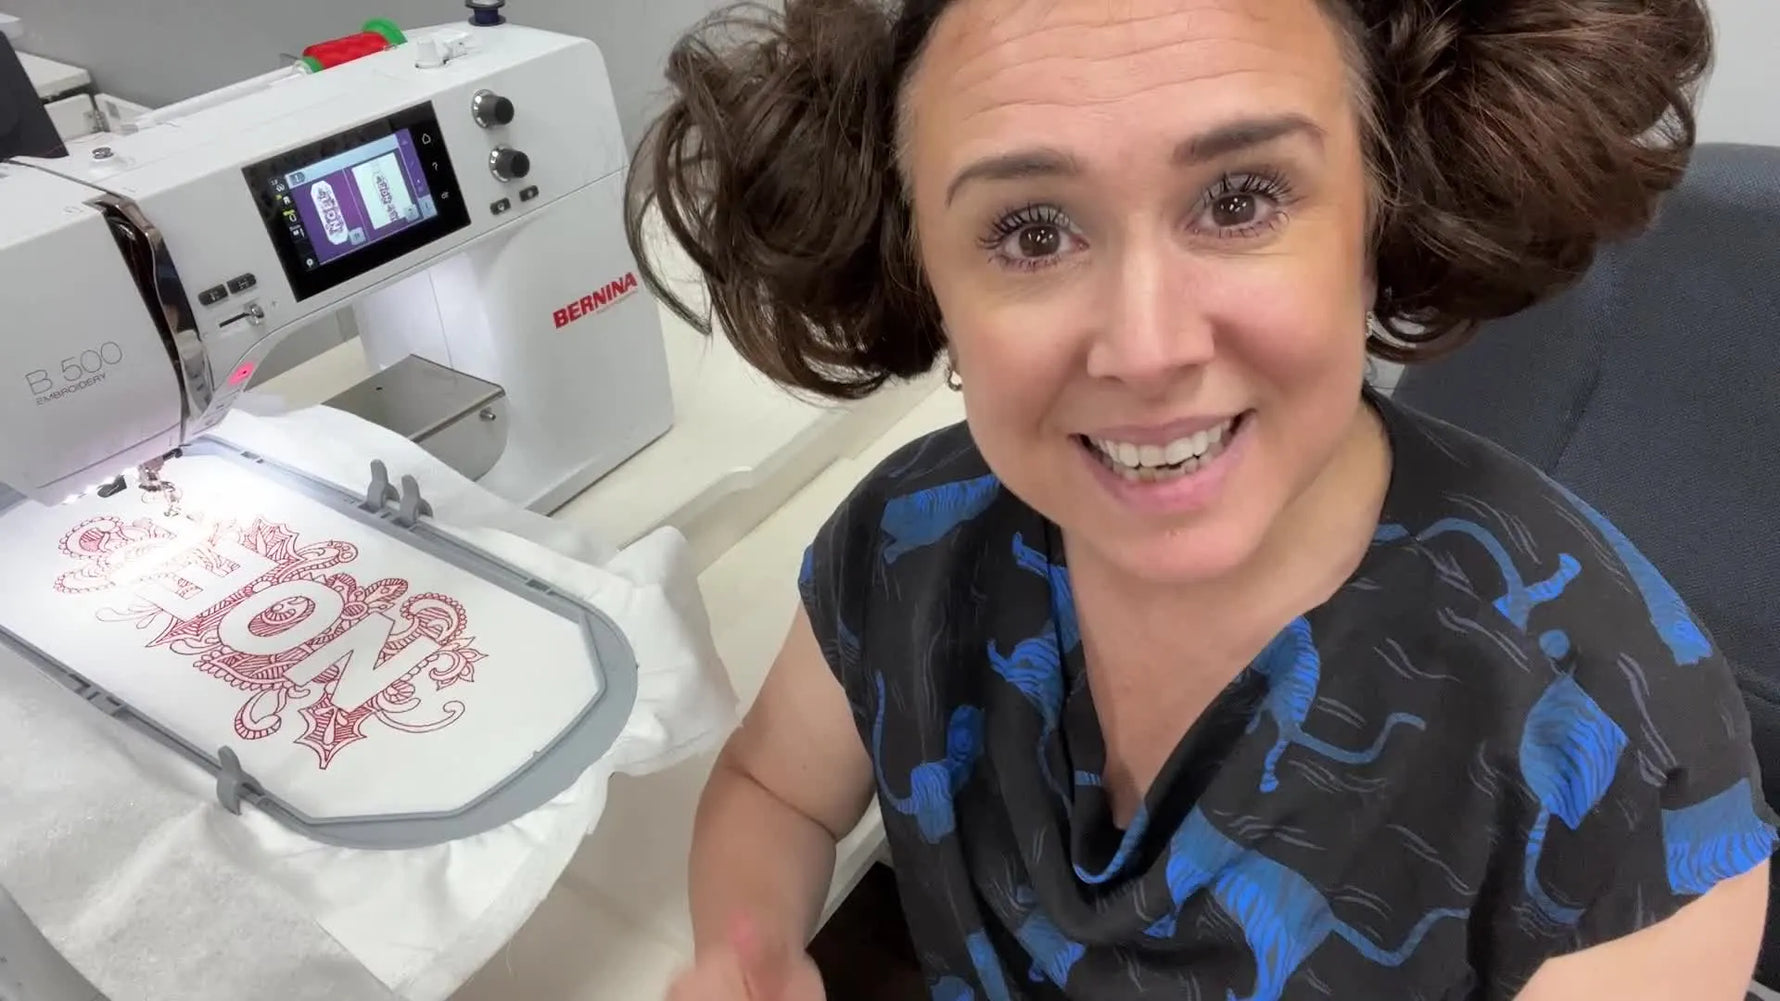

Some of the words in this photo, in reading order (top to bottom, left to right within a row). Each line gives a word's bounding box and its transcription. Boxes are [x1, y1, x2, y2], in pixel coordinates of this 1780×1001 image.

[552, 272, 638, 329] BERNINA
[25, 369, 53, 395] B
[61, 341, 123, 381] 500
[36, 372, 107, 406] EMBROIDERY
